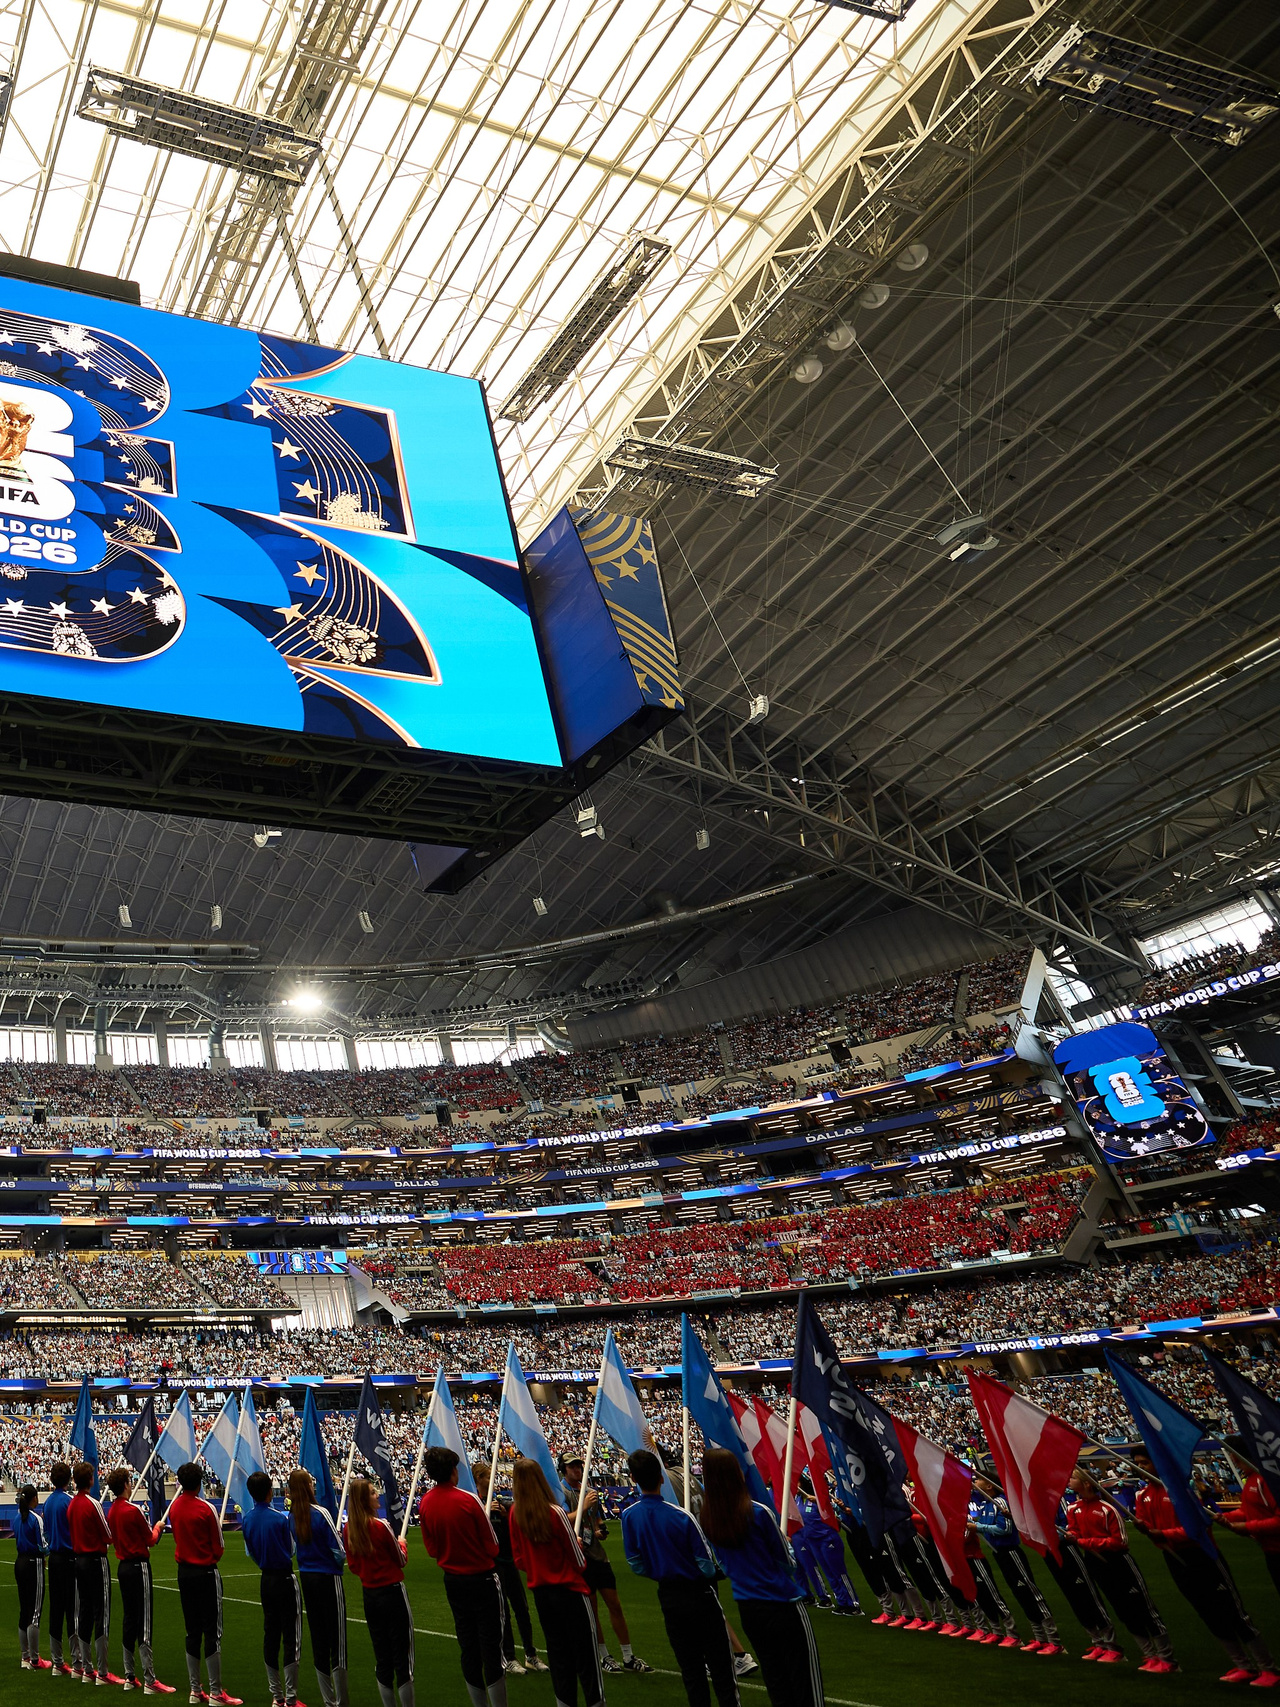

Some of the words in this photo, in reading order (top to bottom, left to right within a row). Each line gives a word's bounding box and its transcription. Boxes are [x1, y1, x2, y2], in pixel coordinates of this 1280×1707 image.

[30, 524, 77, 541] CUP
[1138, 1002, 1172, 1019] FIFA
[1170, 982, 1228, 1011] WORLD
[1228, 970, 1260, 989] CUP
[538, 1136, 561, 1147] FIFA
[560, 1132, 600, 1145] WORLD
[600, 1129, 623, 1140] CUP
[623, 1124, 663, 1137] 2026
[805, 1126, 866, 1144] DALLAS
[153, 1149, 173, 1158] FIFA
[173, 1149, 207, 1158] WORLD
[209, 1149, 227, 1158] CUP
[228, 1149, 261, 1158] 2026
[919, 1152, 947, 1164] FIFA
[948, 1142, 991, 1159] WORLD
[992, 1137, 1019, 1149] CUP
[1019, 1126, 1067, 1144] 2026
[565, 1168, 586, 1177] FIFA
[584, 1164, 611, 1176] WORLD
[612, 1164, 630, 1172] CUP
[630, 1159, 660, 1170] 2026
[394, 1179, 440, 1188] DALLAS
[309, 1216, 329, 1225] FIFA
[329, 1216, 359, 1225] WORLD
[360, 1215, 380, 1224] CUP
[380, 1215, 410, 1224] 2026
[975, 1342, 1001, 1353] FIFA
[999, 1338, 1038, 1352] WORLD
[1037, 1336, 1060, 1348] CUP
[1059, 1333, 1100, 1345] 2026
[167, 1379, 184, 1388] FIFA
[185, 1379, 211, 1388] WORLD
[210, 1378, 226, 1387] CUP
[226, 1378, 253, 1387] 2026
[534, 1373, 551, 1381] FIFA
[551, 1372, 578, 1382] WORLD
[578, 1371, 595, 1380] CUP
